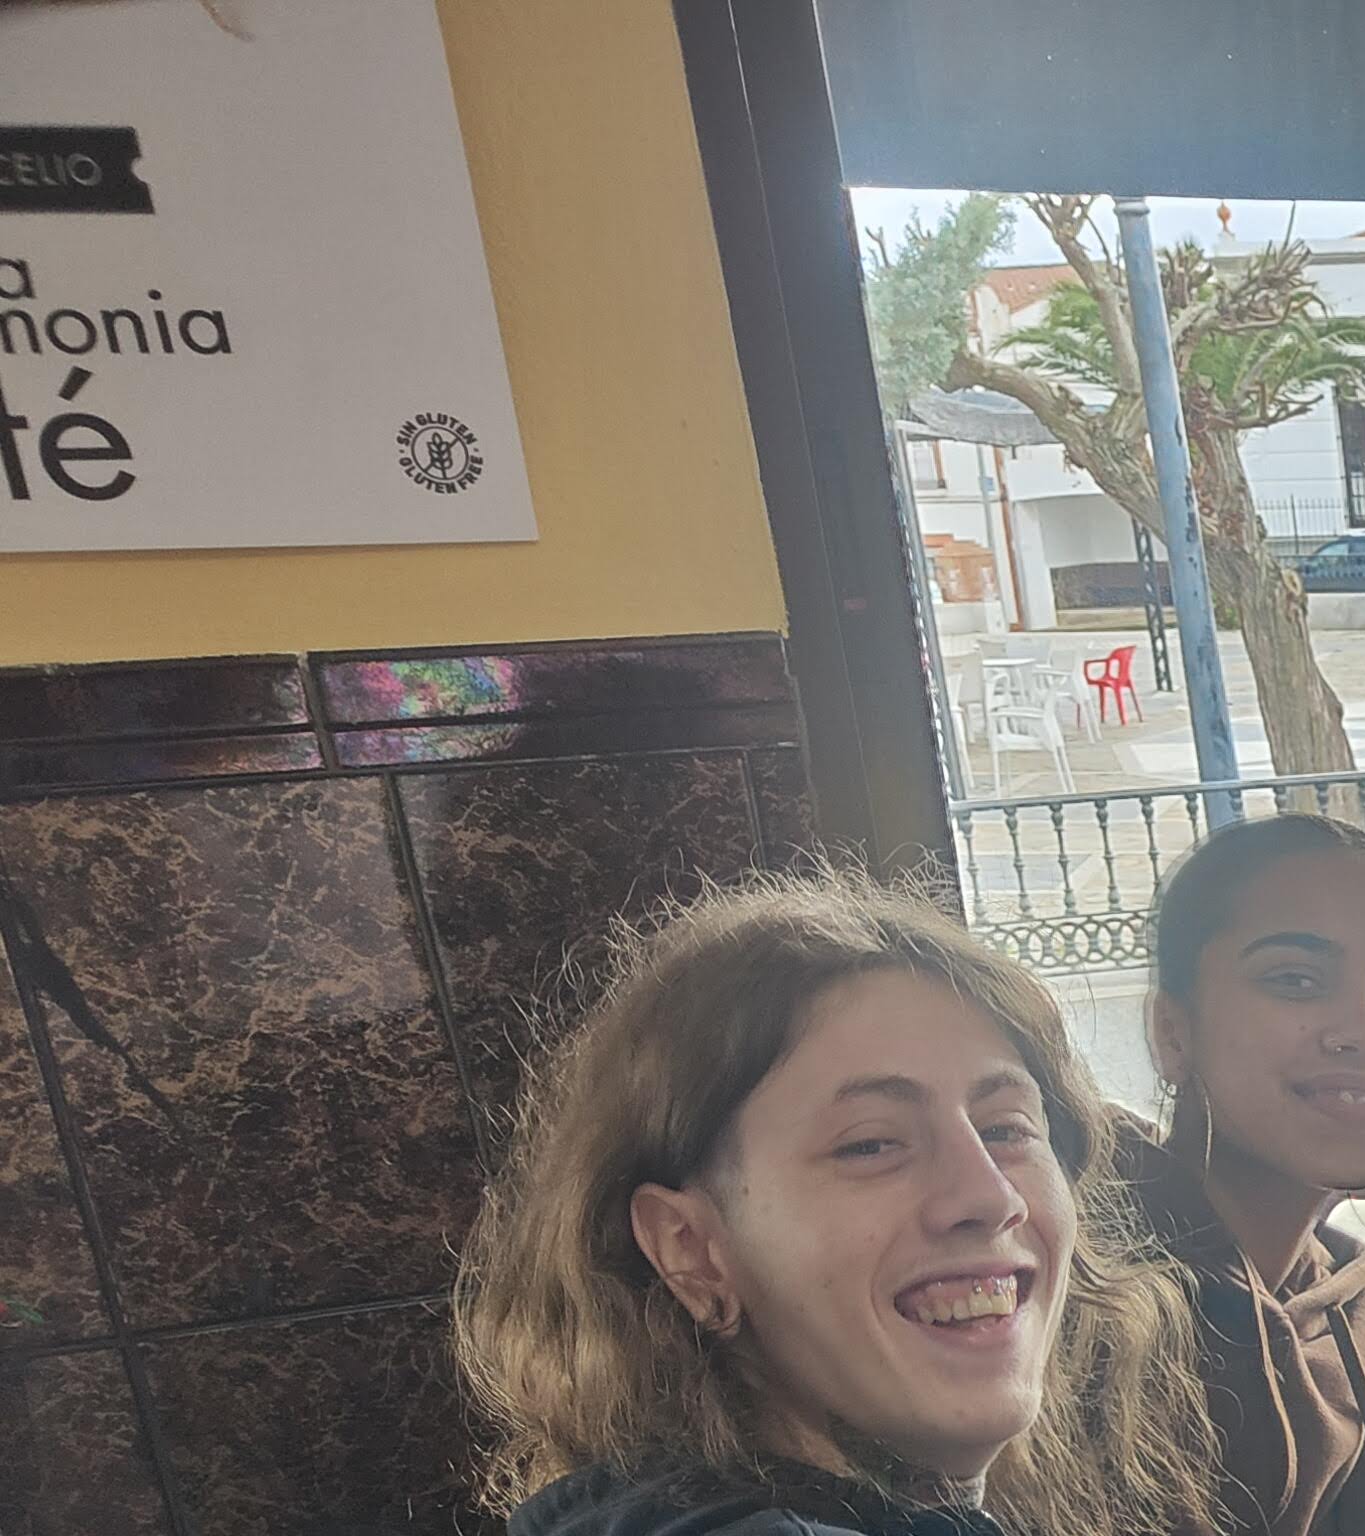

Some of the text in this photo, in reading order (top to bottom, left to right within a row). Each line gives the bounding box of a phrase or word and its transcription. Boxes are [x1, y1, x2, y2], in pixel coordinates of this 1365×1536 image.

[396, 411, 478, 447] SIN GLUTEN
[398, 454, 484, 494] GLUTEN FREE
